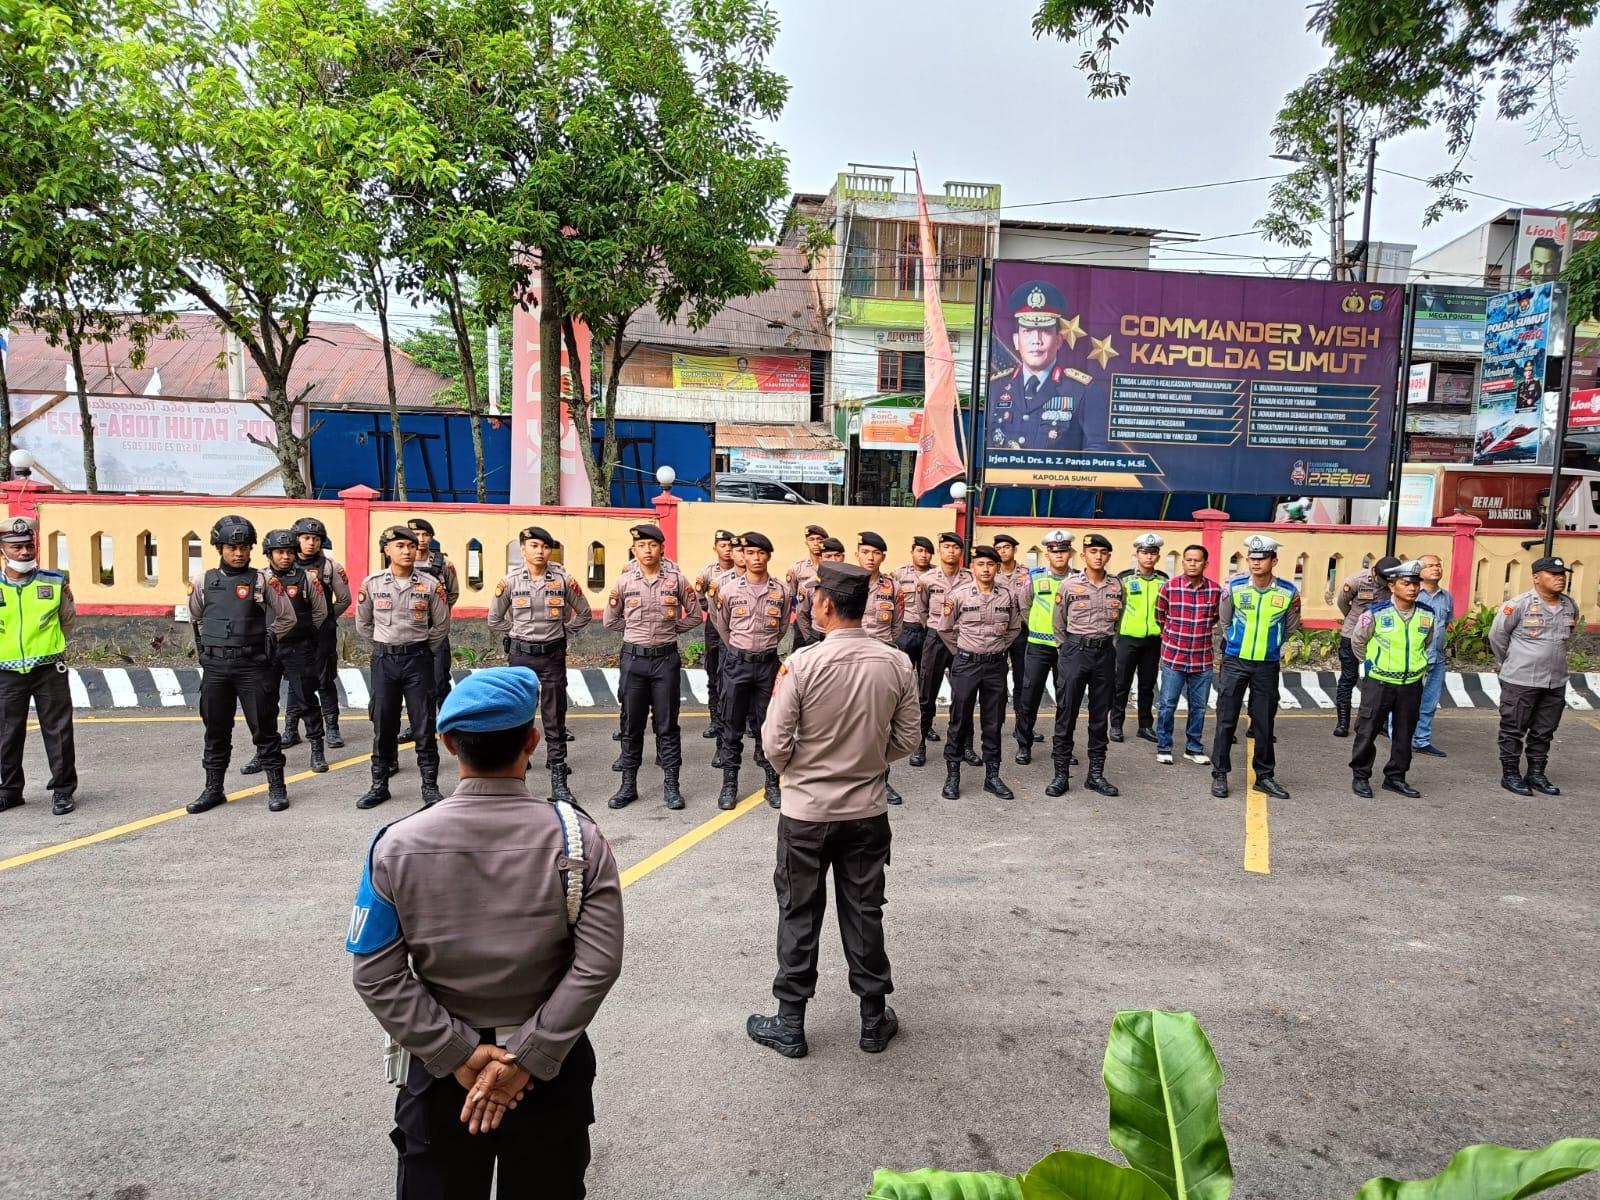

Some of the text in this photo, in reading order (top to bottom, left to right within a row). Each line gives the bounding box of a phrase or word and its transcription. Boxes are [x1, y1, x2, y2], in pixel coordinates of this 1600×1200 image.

[1525, 225, 1554, 237] Lion
[1487, 313, 1548, 334] POLDA SUMUT
[1120, 314, 1380, 349] COMMANDER WISH
[1131, 342, 1367, 374] KAPOLDA SUMUT
[1571, 399, 1591, 410] Lion
[989, 455, 1008, 464] Irjen
[1010, 455, 1025, 463] Pol.
[1028, 456, 1044, 464] Drs.
[1056, 457, 1063, 465] Z.
[1065, 458, 1090, 466] Panca
[1092, 459, 1115, 467] Putra
[1309, 472, 1371, 485] PRESISI
[1472, 496, 1503, 509] BERANI
[1488, 509, 1532, 520] DIANDELIN
